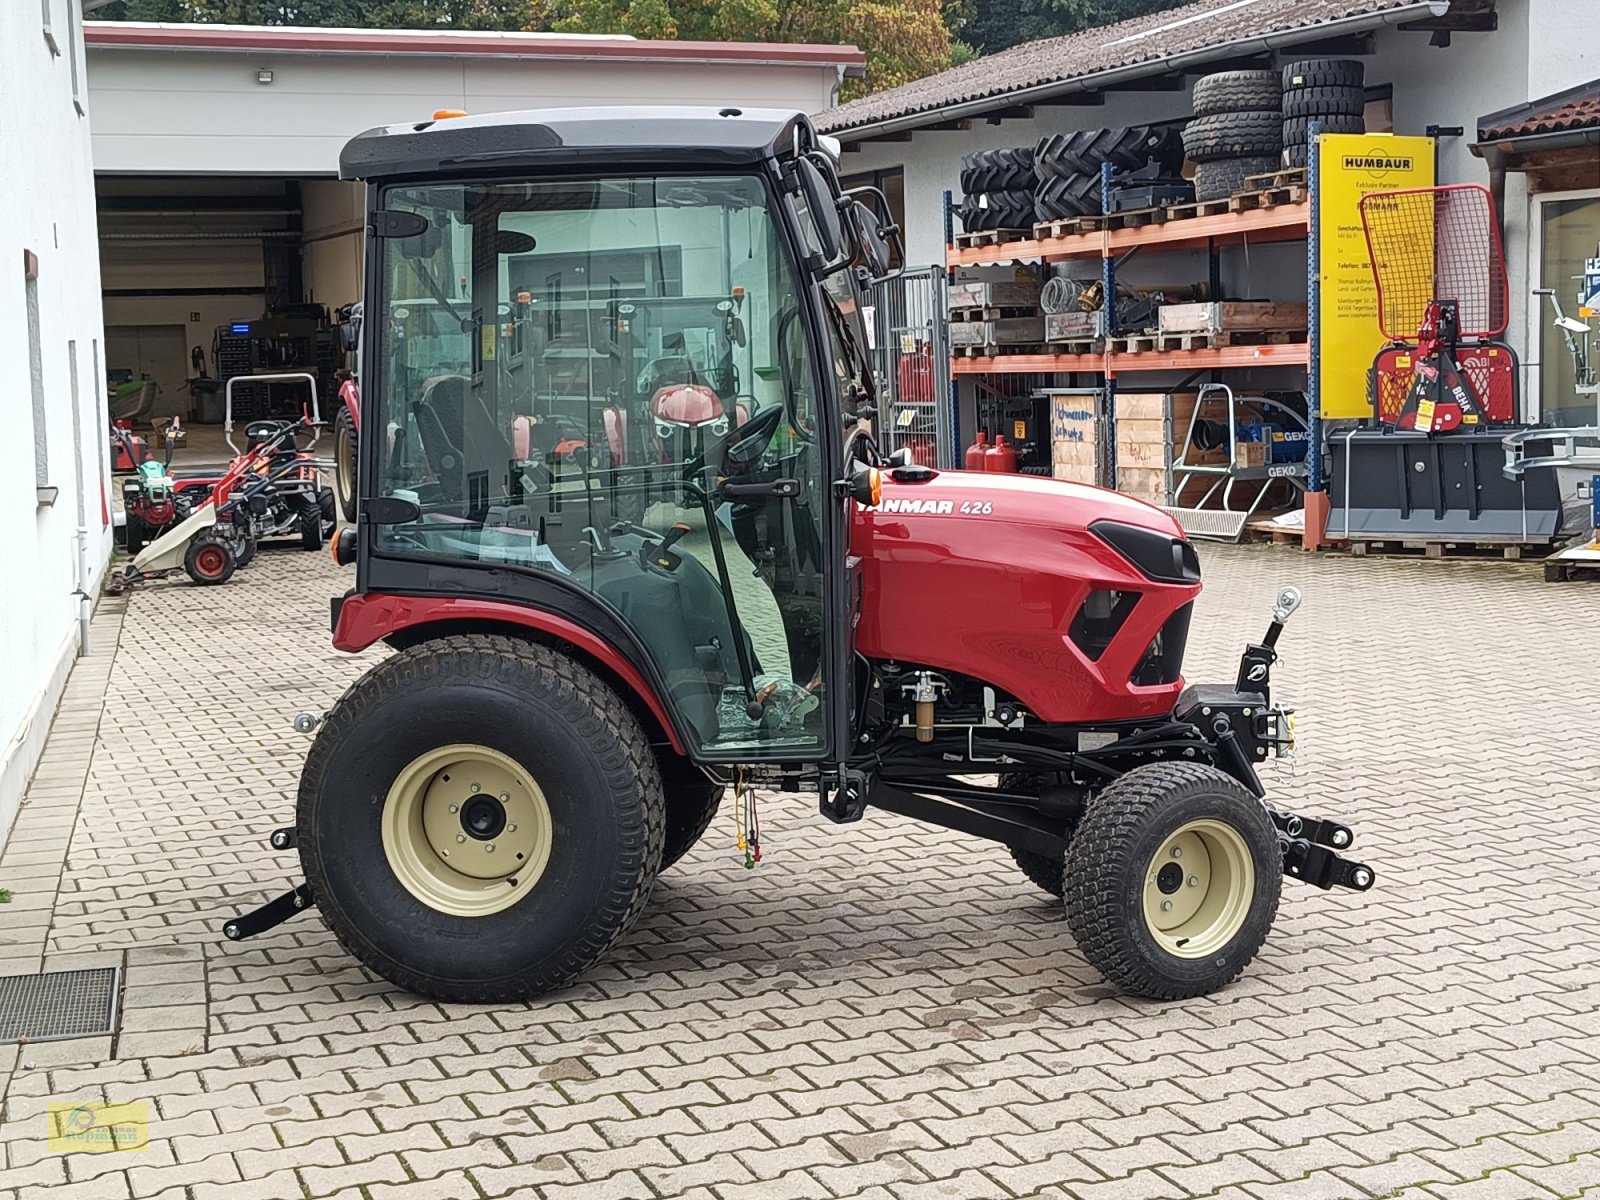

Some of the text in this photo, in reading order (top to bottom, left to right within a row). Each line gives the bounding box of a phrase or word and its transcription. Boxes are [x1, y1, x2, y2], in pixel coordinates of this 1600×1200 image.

[1345, 158, 1410, 169] HUMBAUR
[1452, 386, 1471, 412] BEHA
[1268, 465, 1296, 477] GEKO
[959, 501, 993, 515] 426
